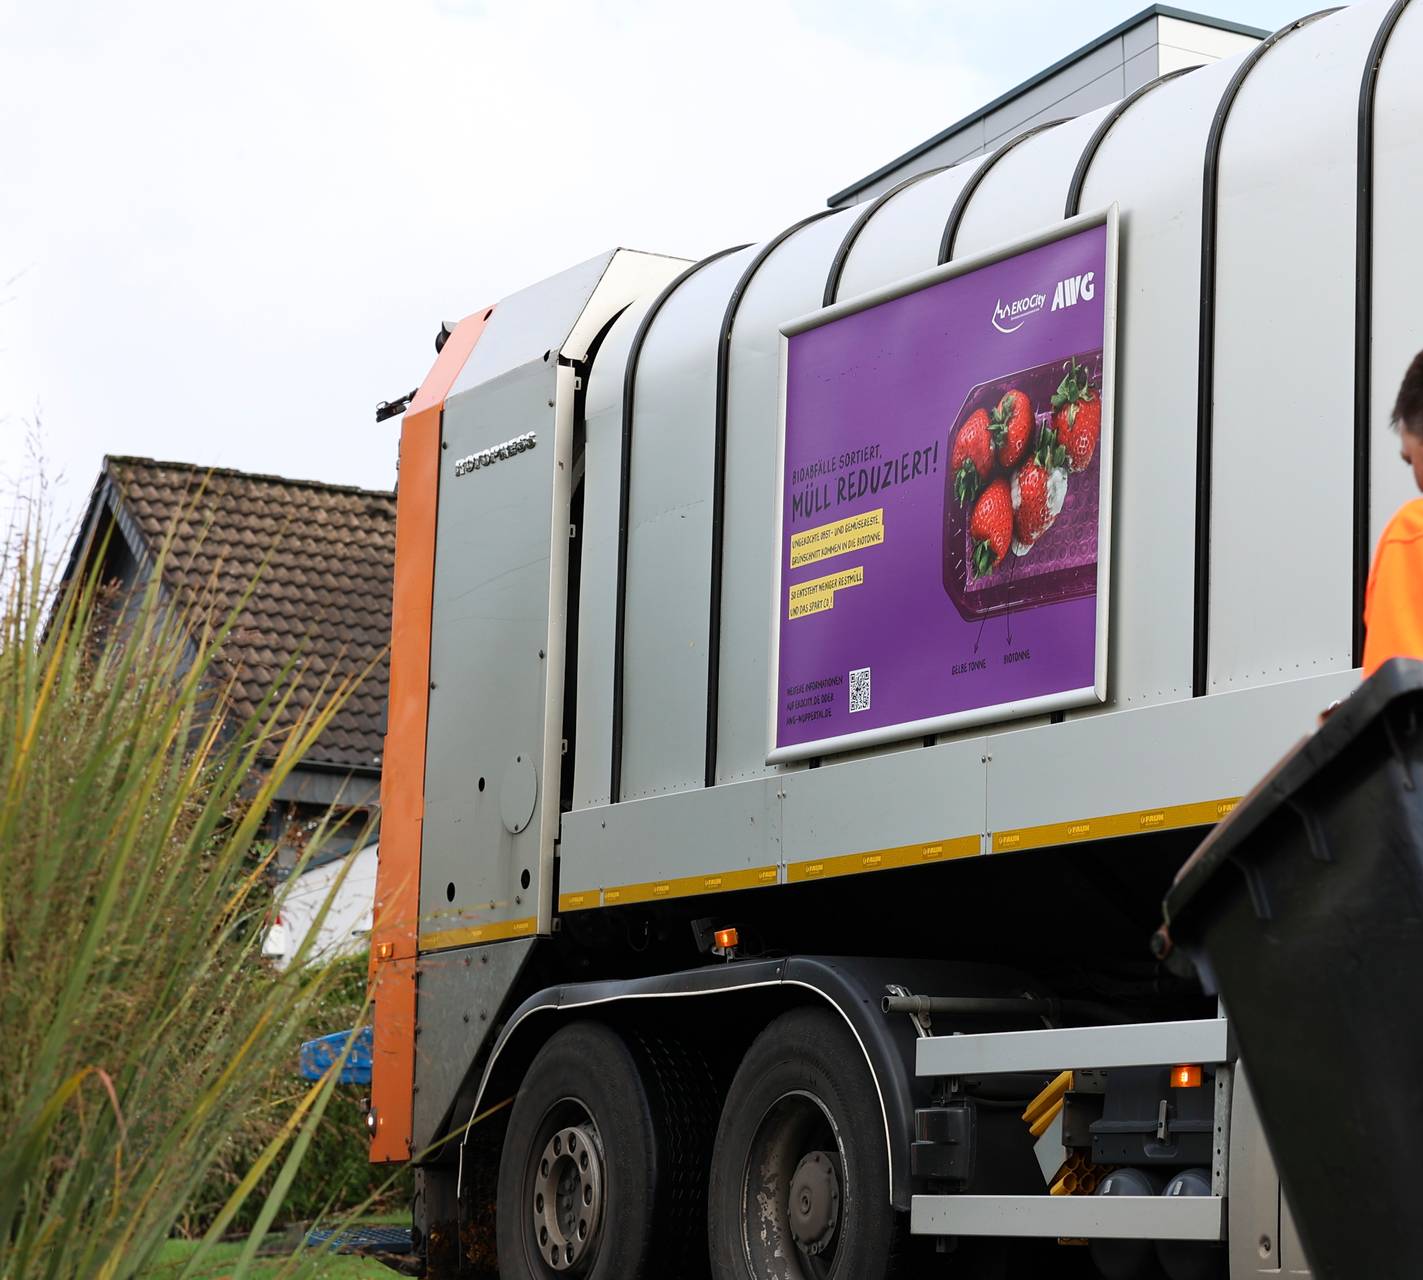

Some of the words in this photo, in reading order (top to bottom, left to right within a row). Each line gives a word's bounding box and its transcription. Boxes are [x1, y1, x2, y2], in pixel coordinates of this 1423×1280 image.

[1011, 293, 1046, 315] EKOCity
[1051, 271, 1095, 312] AWG
[455, 431, 536, 477] ROTOPRESS
[792, 456, 837, 486] BIOABFÄLLE
[792, 482, 831, 522] MÜLL
[835, 440, 939, 505] REDUZIERT!
